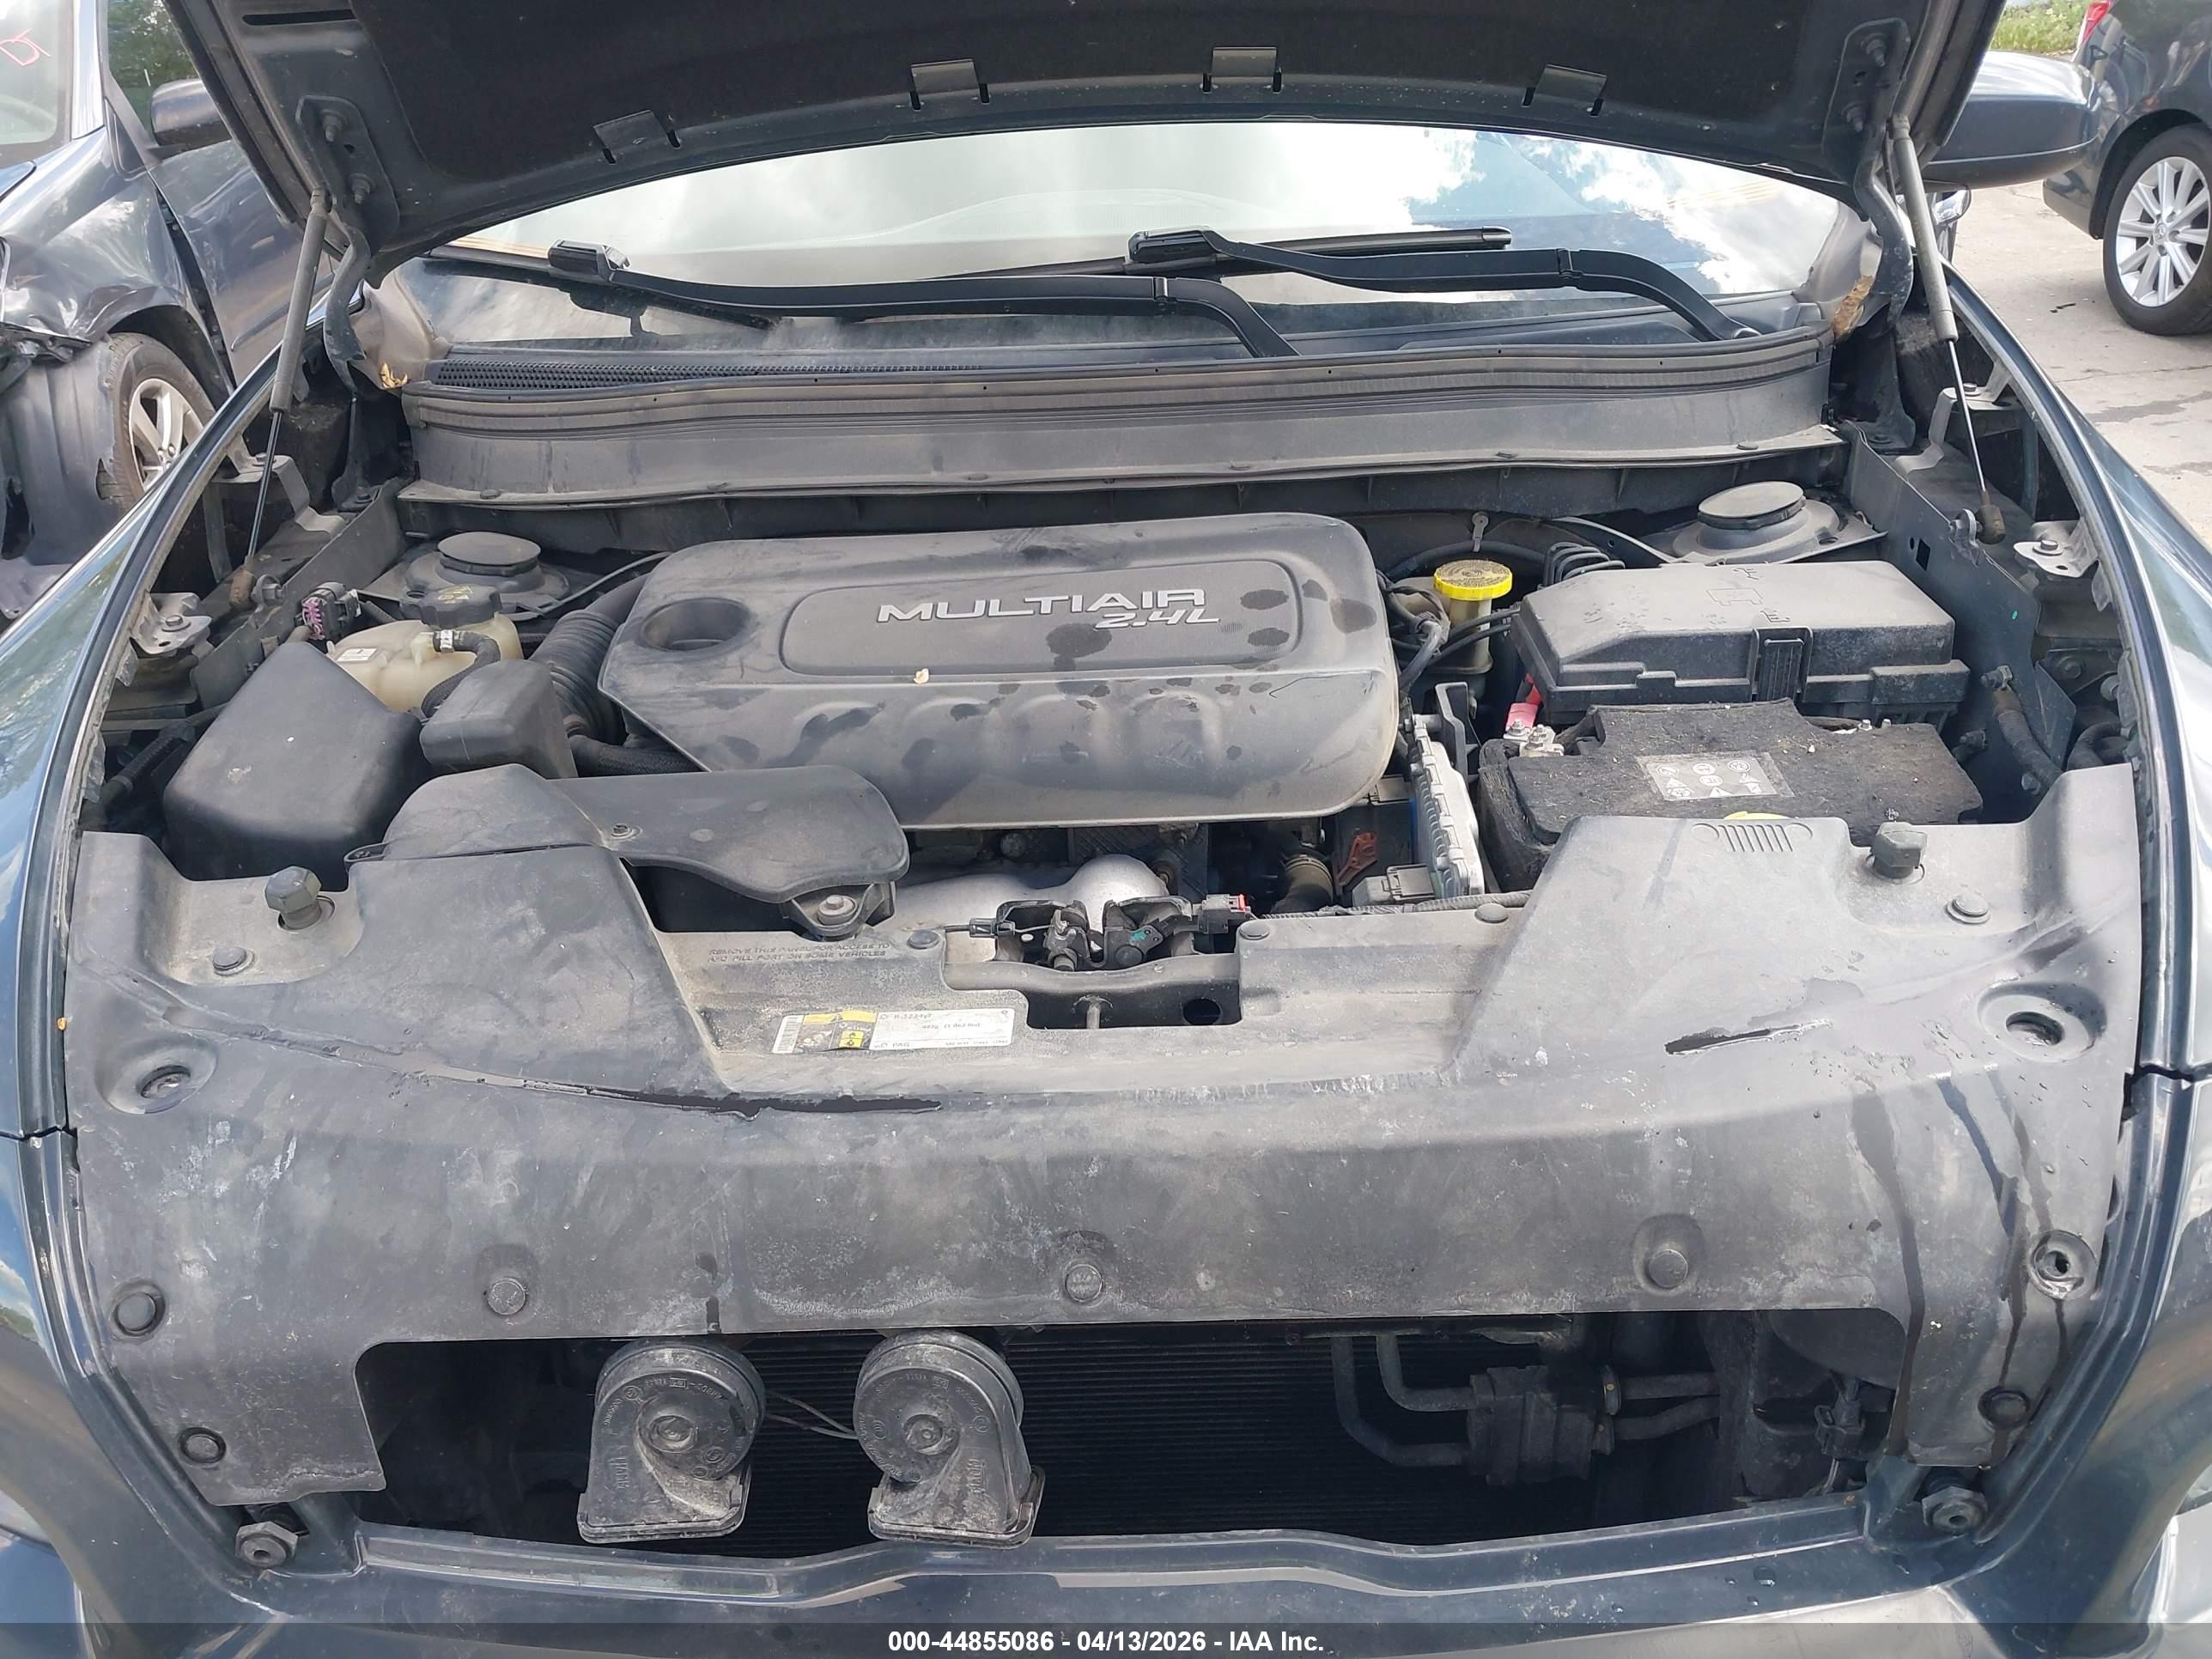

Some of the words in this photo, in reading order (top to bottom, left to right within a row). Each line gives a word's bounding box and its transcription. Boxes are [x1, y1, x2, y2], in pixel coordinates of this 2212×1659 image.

[877, 588, 1206, 623] MULTIAIR
[1093, 607, 1221, 630] 2.4L
[838, 949, 887, 957] VEHICLES
